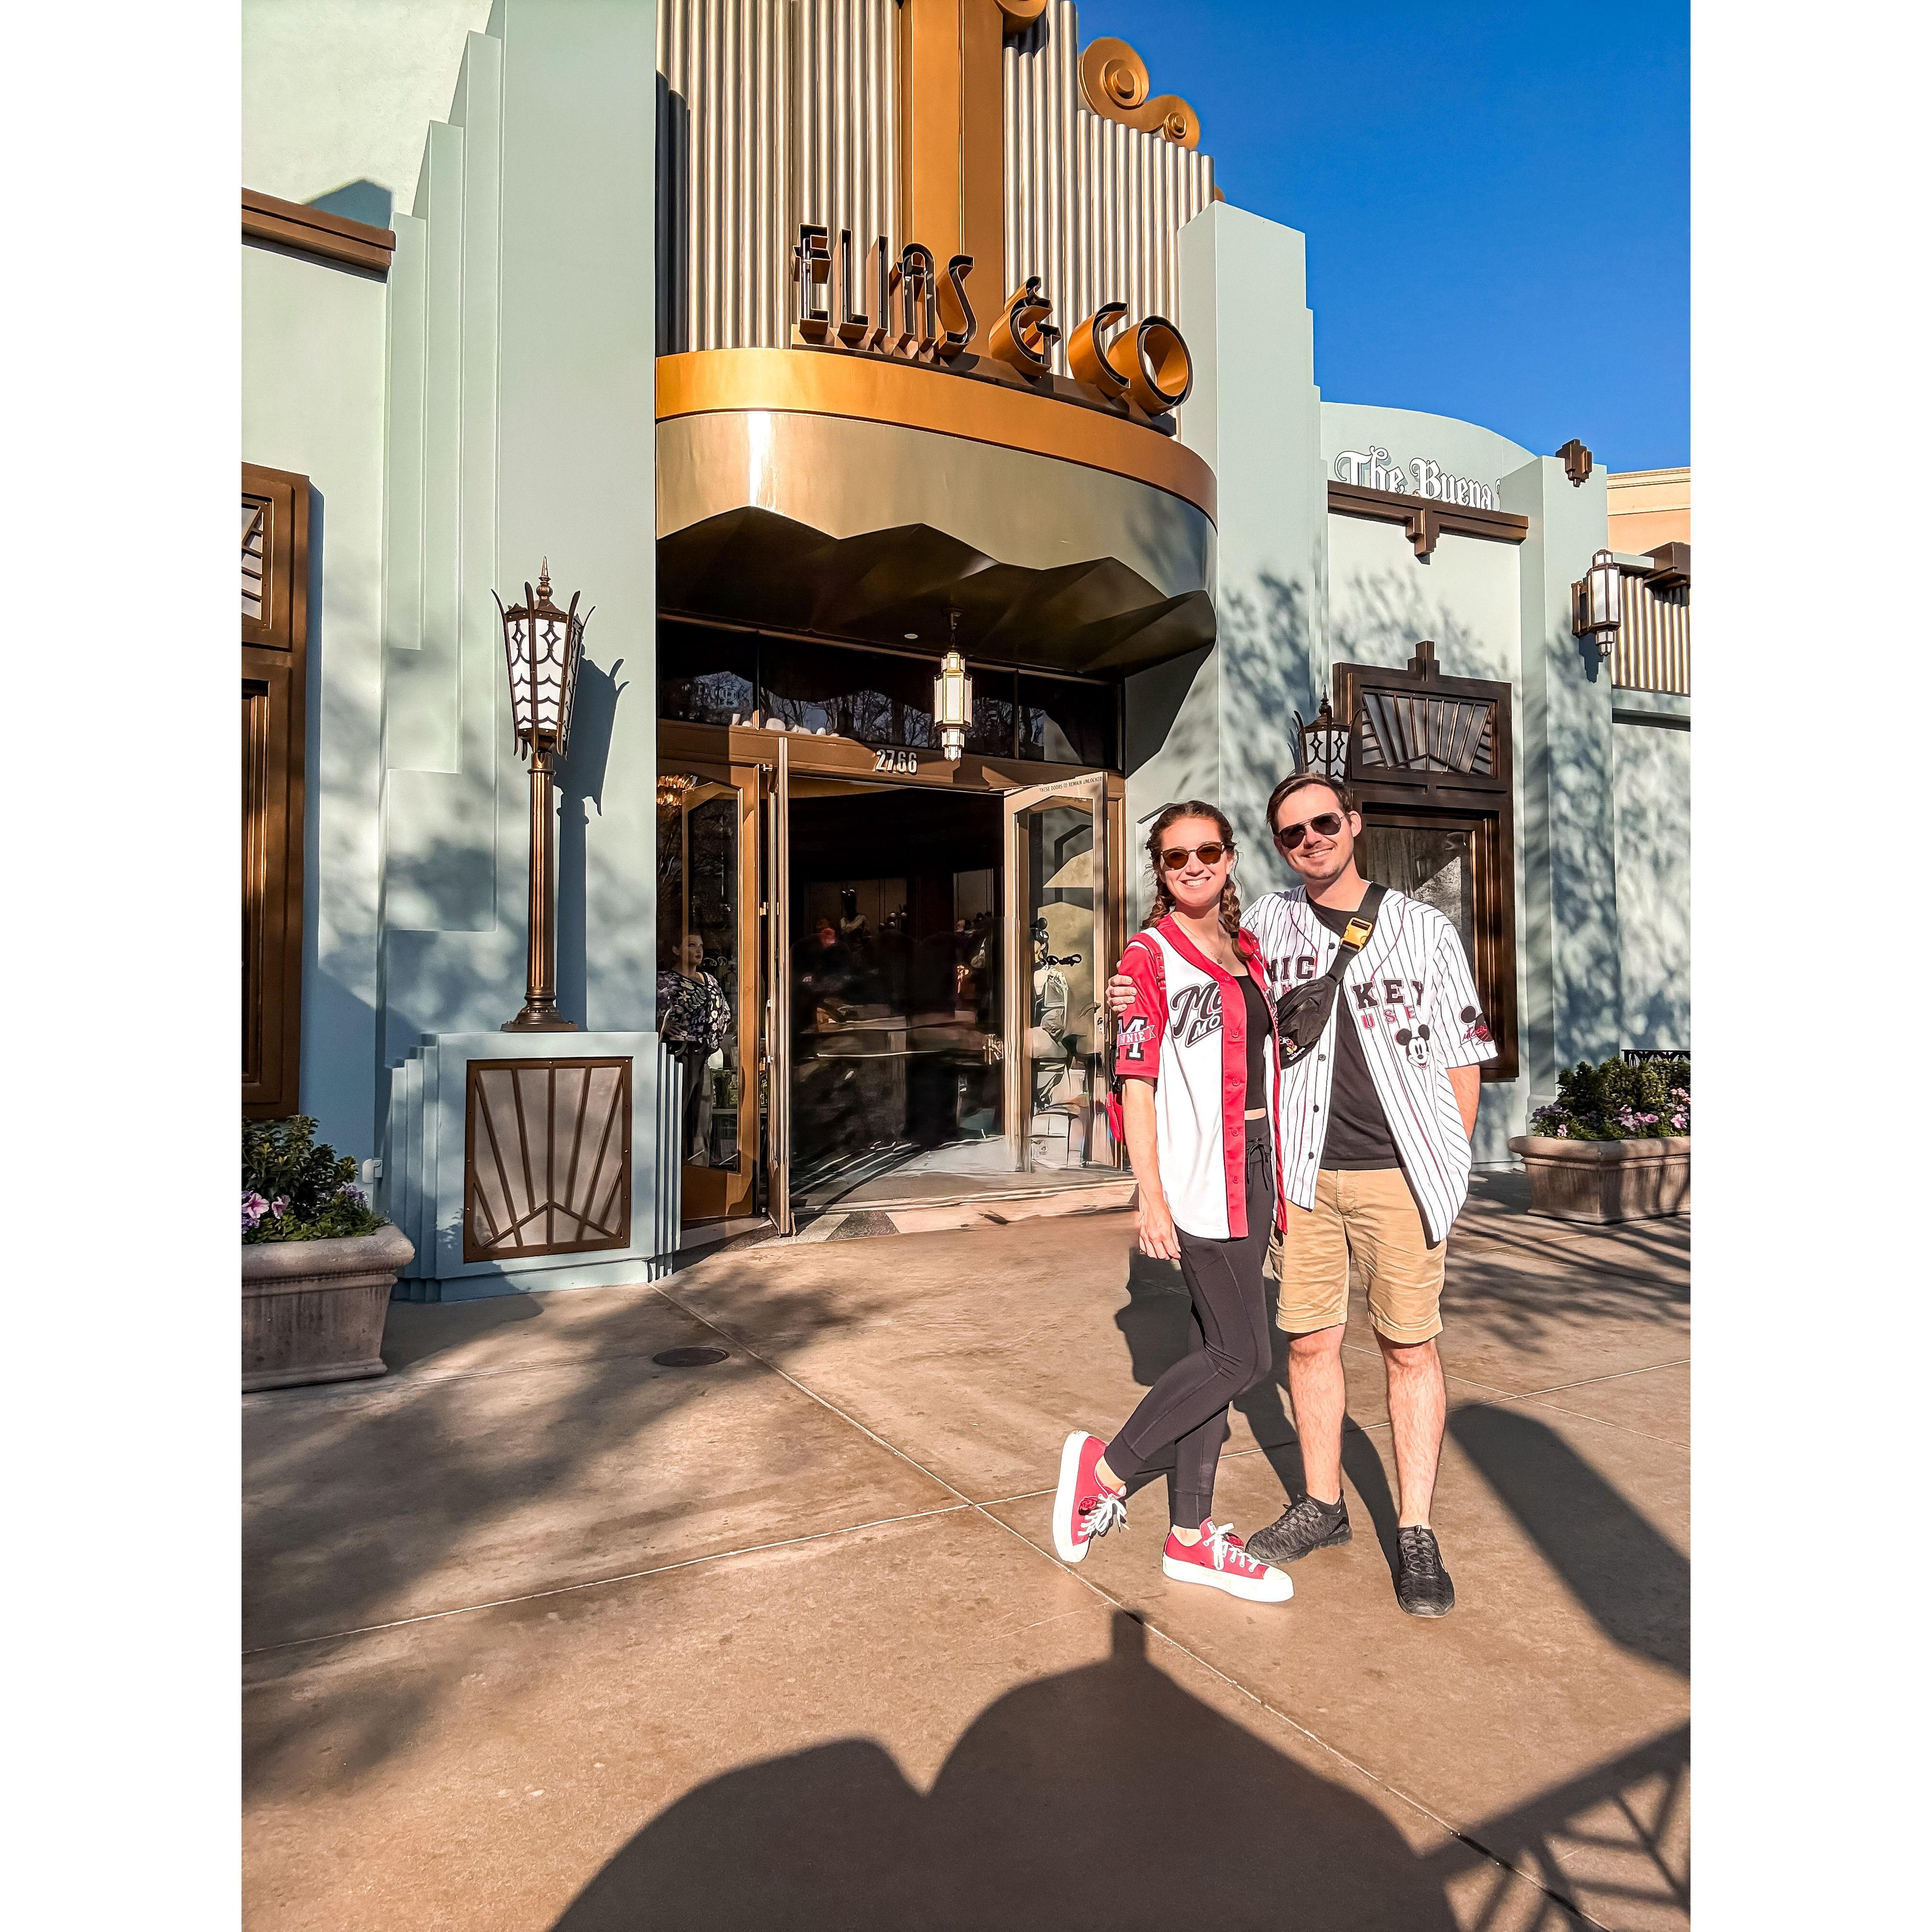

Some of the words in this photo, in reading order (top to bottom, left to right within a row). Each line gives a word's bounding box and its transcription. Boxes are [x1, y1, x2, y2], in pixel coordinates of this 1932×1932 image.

[793, 222, 978, 356] ELIAS
[1068, 301, 1193, 415] CO
[1334, 445, 1405, 494] The
[1409, 457, 1492, 510] Buena
[875, 749, 918, 774] 2766
[1083, 776, 1102, 784] UNLOCKED
[1361, 1004, 1416, 1029] USE
